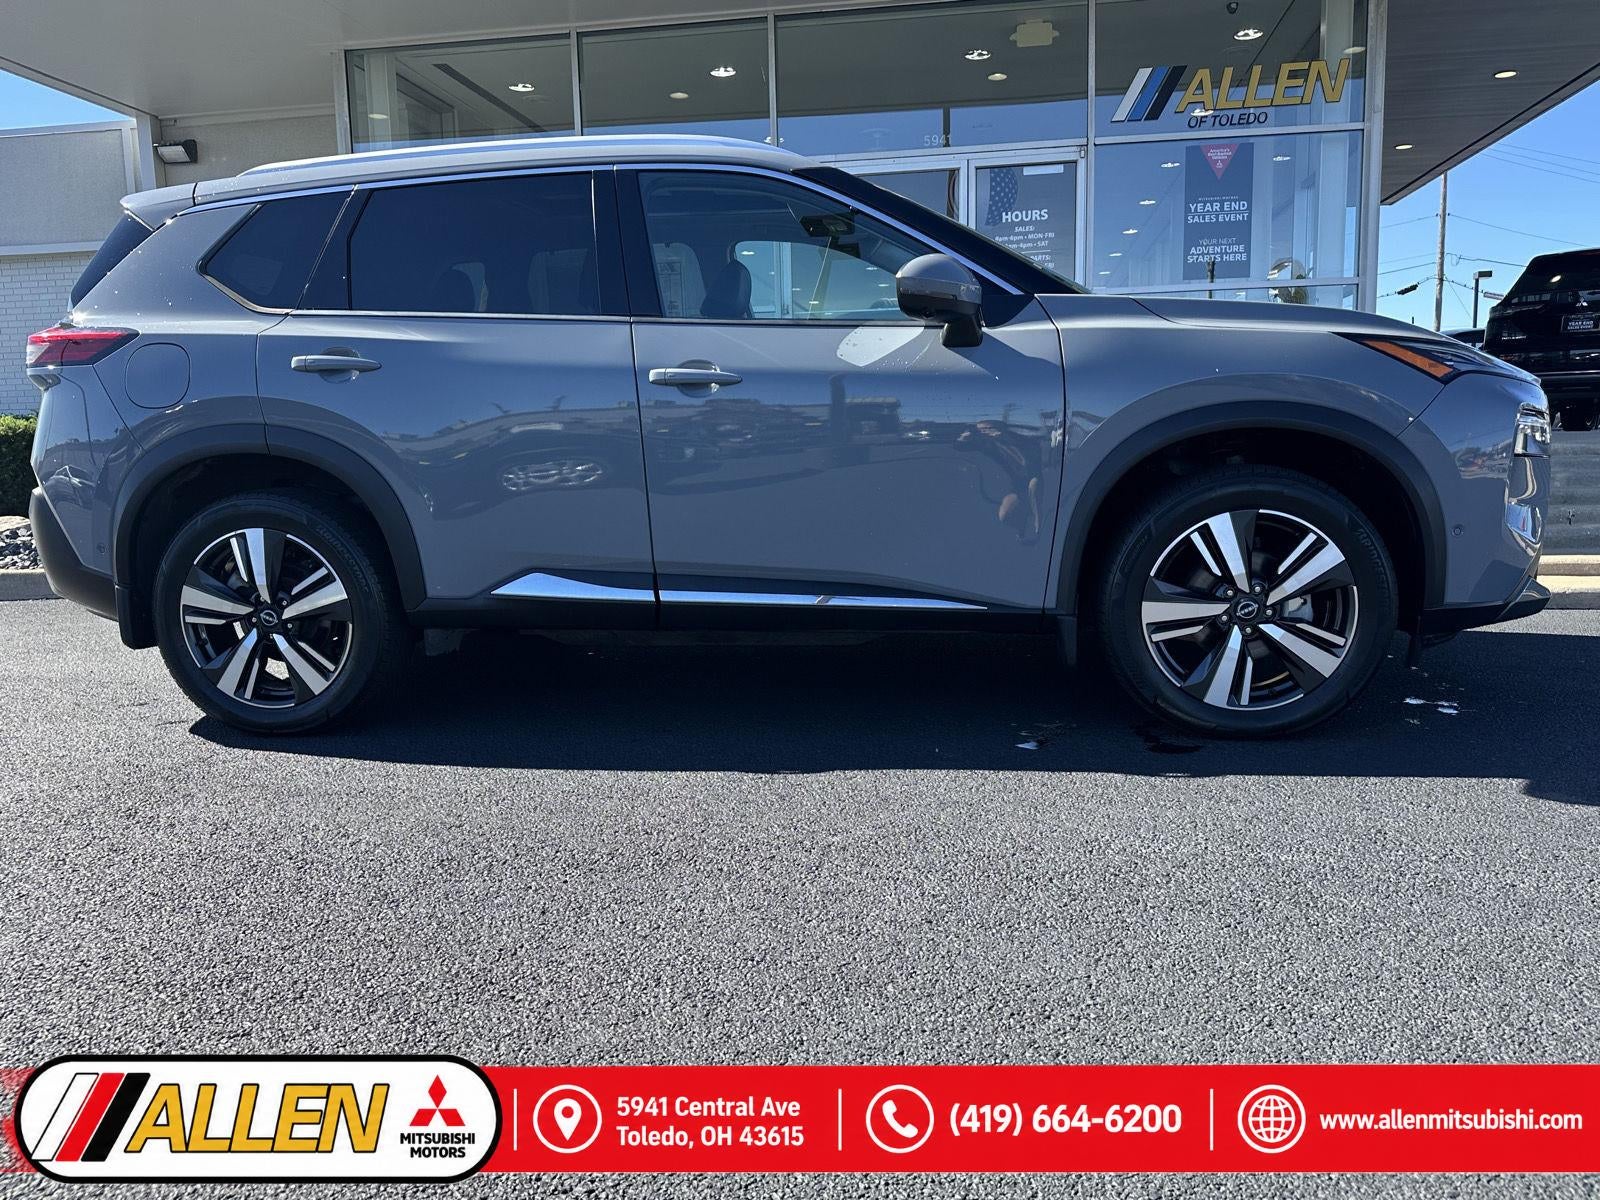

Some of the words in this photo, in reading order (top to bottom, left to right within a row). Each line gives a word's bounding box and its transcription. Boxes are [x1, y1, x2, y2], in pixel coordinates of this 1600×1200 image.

[1174, 58, 1350, 113] ALLEN
[1187, 115, 1207, 128] OF
[1211, 112, 1268, 127] TOLEDO
[924, 134, 951, 146] 5941
[1189, 203, 1220, 213] YEAR
[1224, 201, 1248, 211] END
[1002, 208, 1049, 223] HOURS
[1187, 213, 1216, 224] SALES
[1218, 212, 1249, 222] EVENT
[1199, 238, 1217, 246] YOUR
[1189, 244, 1245, 255] ADVENTURE
[1187, 254, 1221, 263] STARTS
[1223, 253, 1247, 261] HERE
